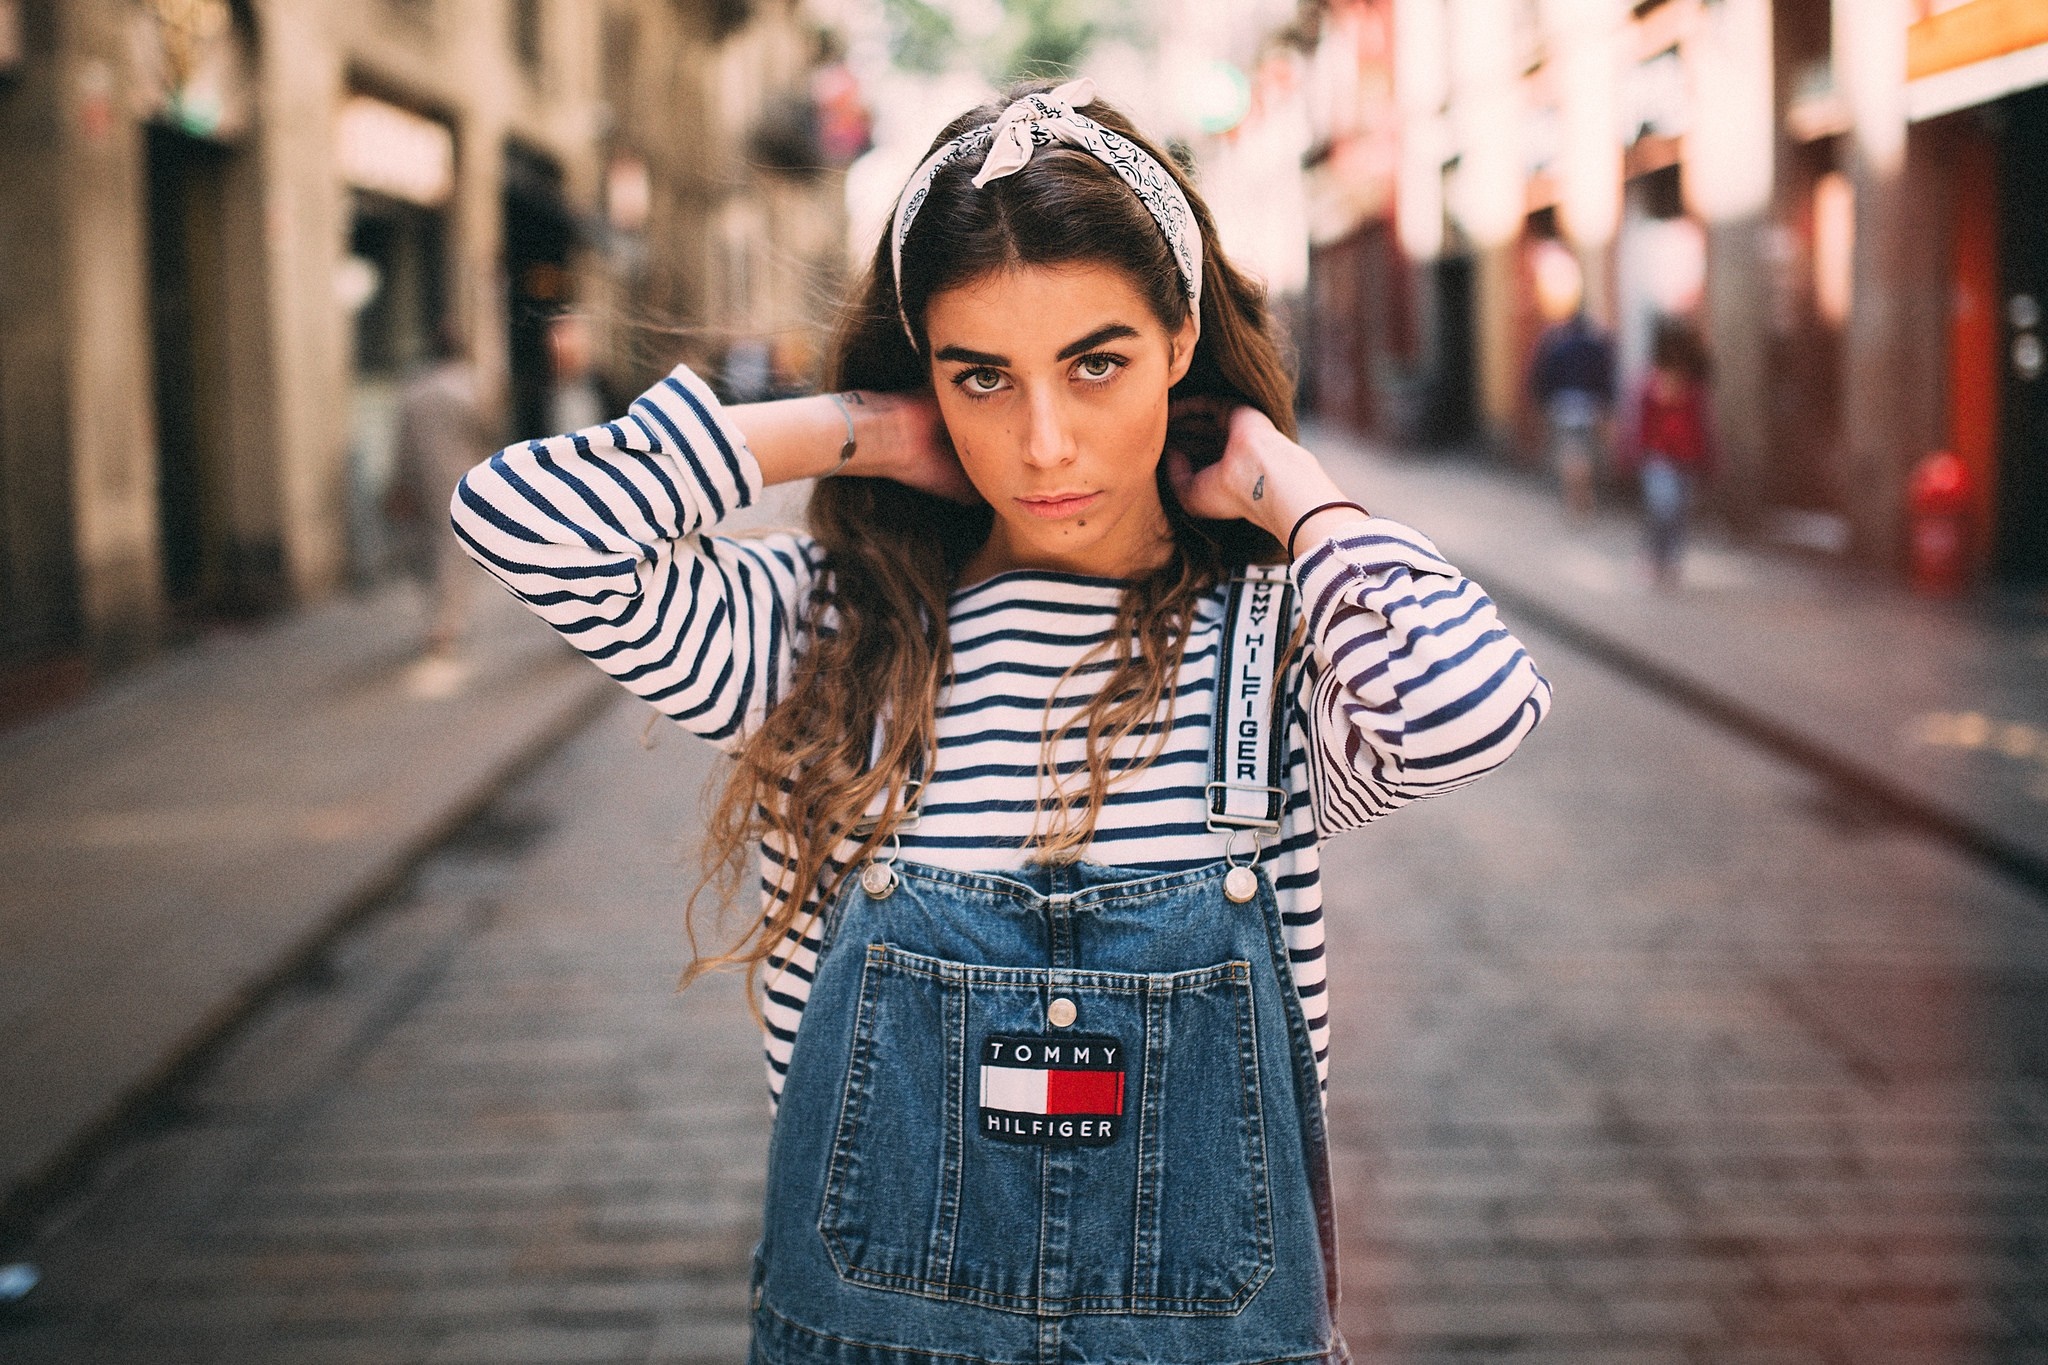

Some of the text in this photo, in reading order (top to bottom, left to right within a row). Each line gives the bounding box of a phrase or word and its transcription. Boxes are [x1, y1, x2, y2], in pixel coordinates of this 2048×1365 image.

[1237, 634, 1264, 780] HILFIGER
[991, 1043, 1116, 1064] TOMMY
[987, 1115, 1112, 1137] HILFIGER
